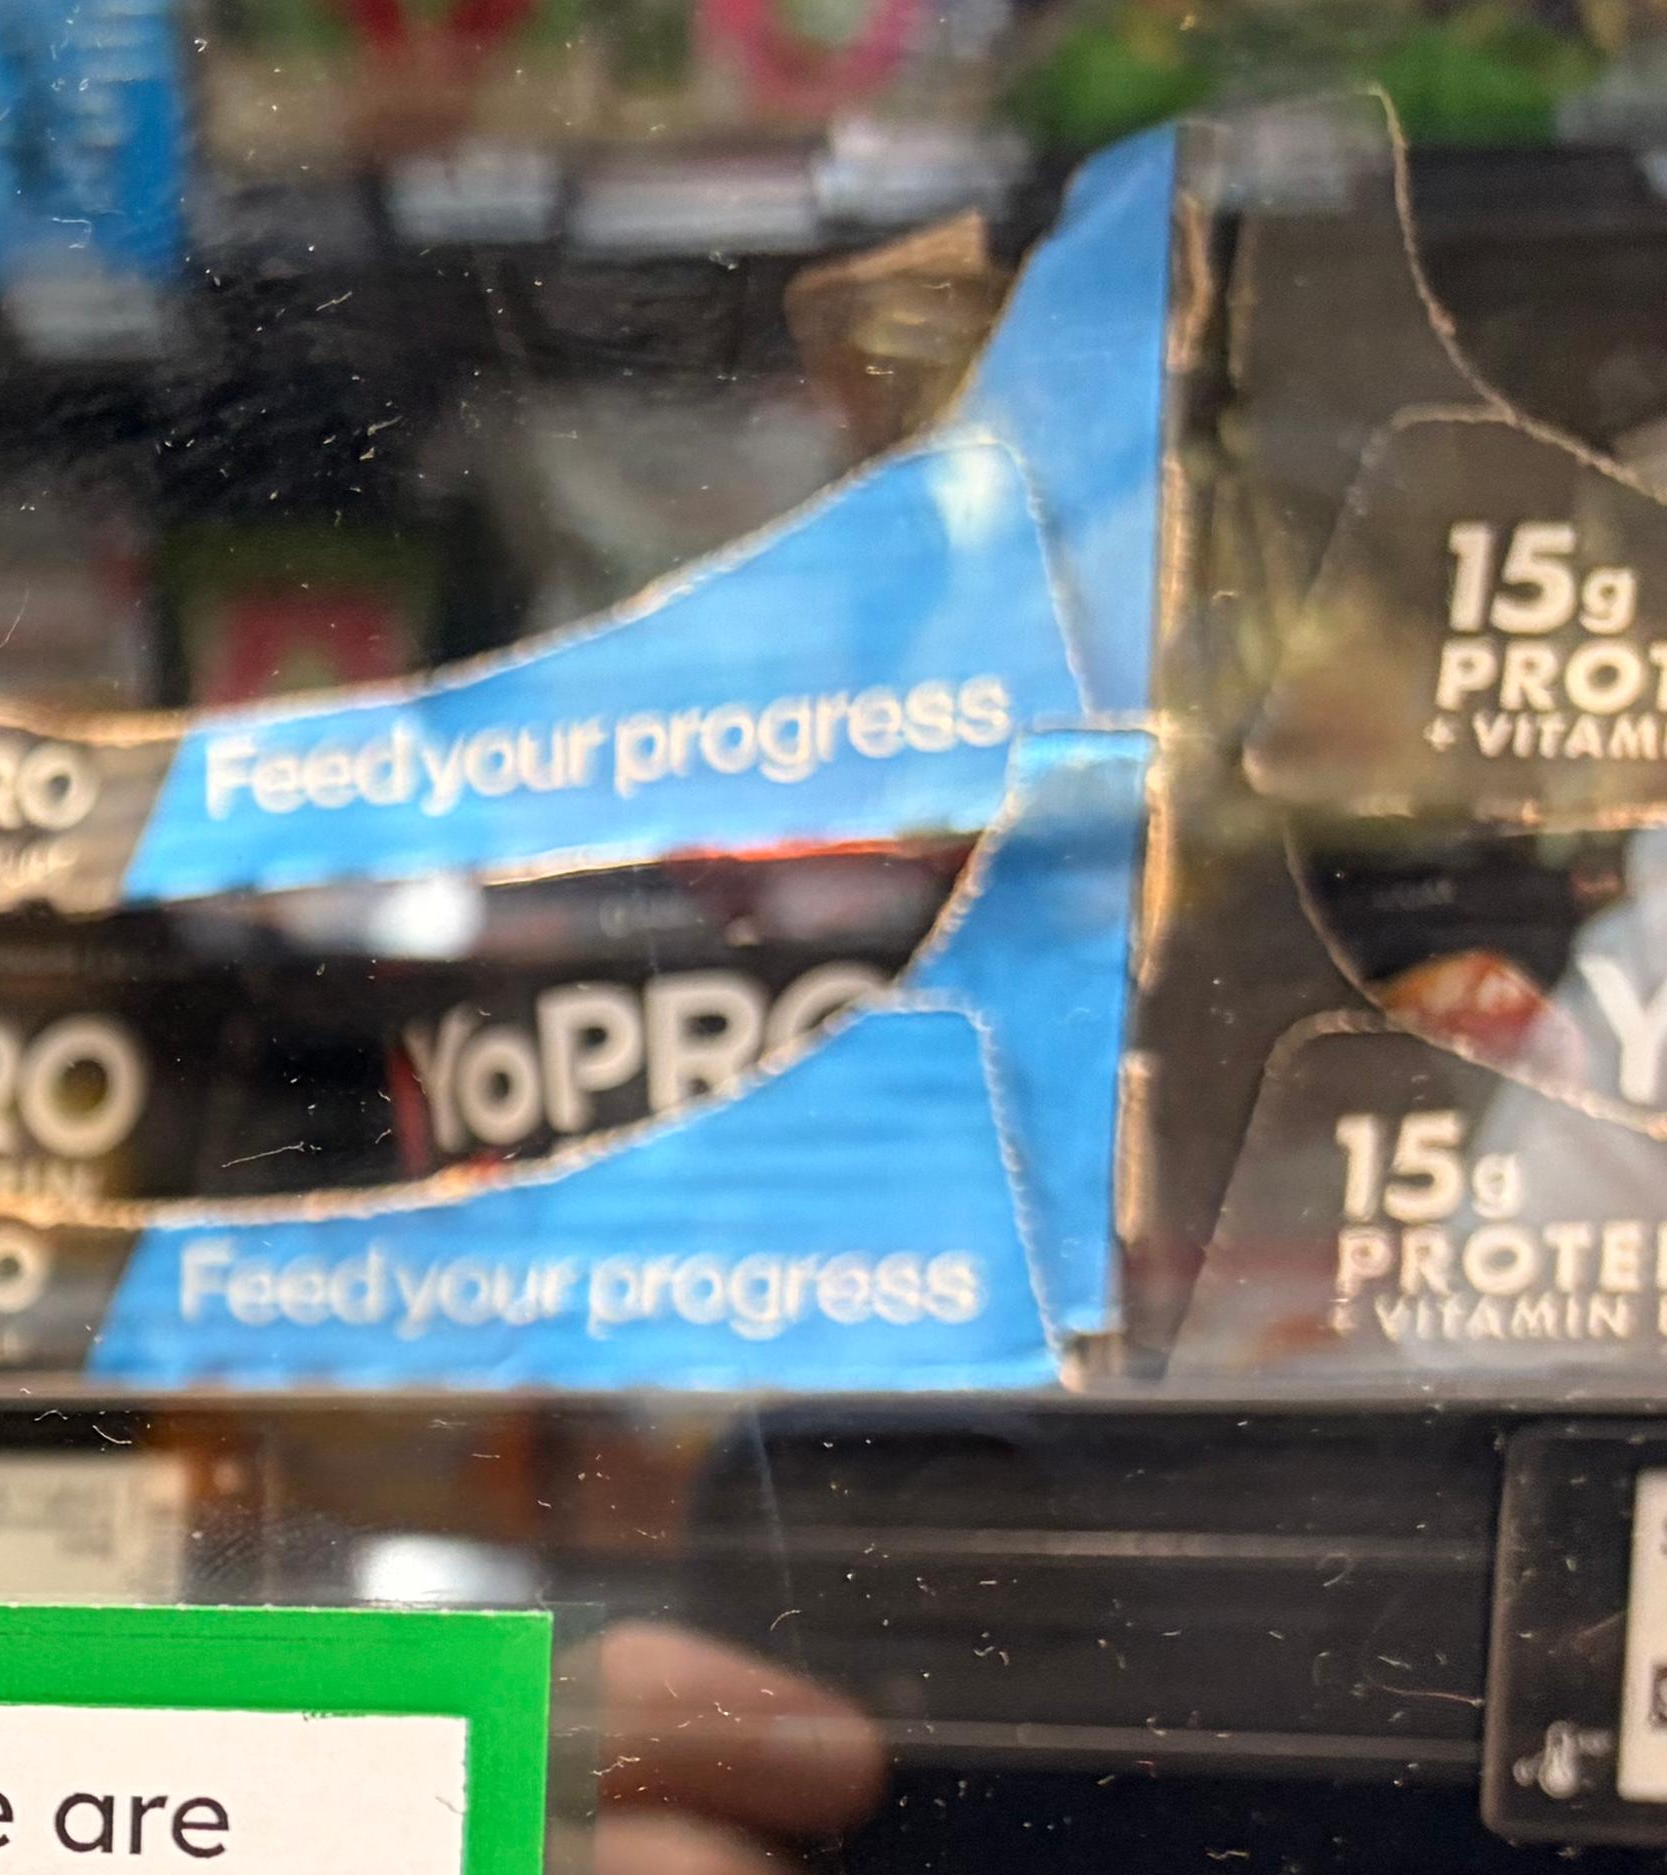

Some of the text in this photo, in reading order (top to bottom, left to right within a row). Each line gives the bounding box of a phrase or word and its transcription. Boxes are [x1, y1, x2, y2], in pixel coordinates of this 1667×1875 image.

[1447, 520, 1637, 635] 15g
[202, 675, 1012, 820] Feed your progress
[1334, 1110, 1524, 1222] 15g
[178, 1236, 989, 1342] Feed your progress
[55, 1792, 230, 1859] are
